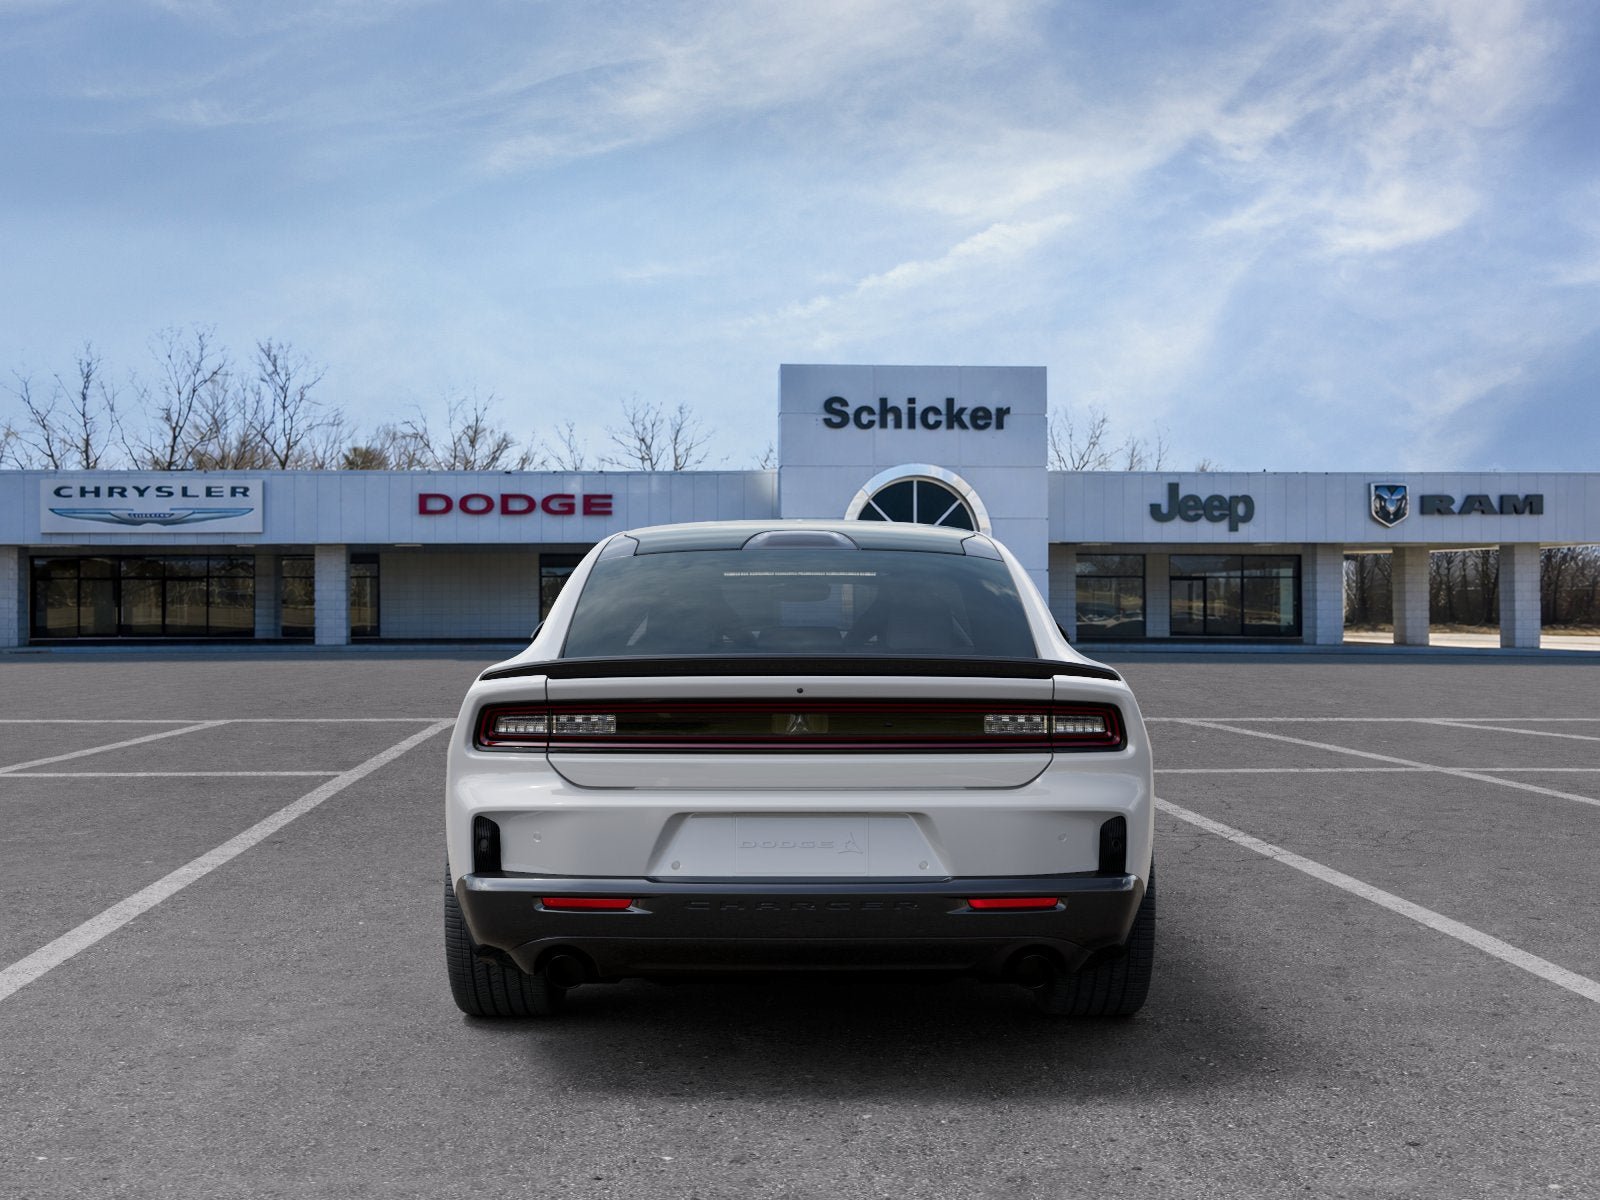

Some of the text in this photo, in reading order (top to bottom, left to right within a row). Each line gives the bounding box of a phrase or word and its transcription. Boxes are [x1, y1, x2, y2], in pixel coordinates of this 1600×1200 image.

[823, 396, 1011, 430] Schicker
[53, 486, 251, 499] CHRYSLER
[418, 493, 613, 516] DODGE
[1149, 482, 1255, 532] Jeep
[1420, 494, 1544, 516] RAM
[739, 840, 834, 849] DODGE
[684, 900, 920, 911] CHARGER
